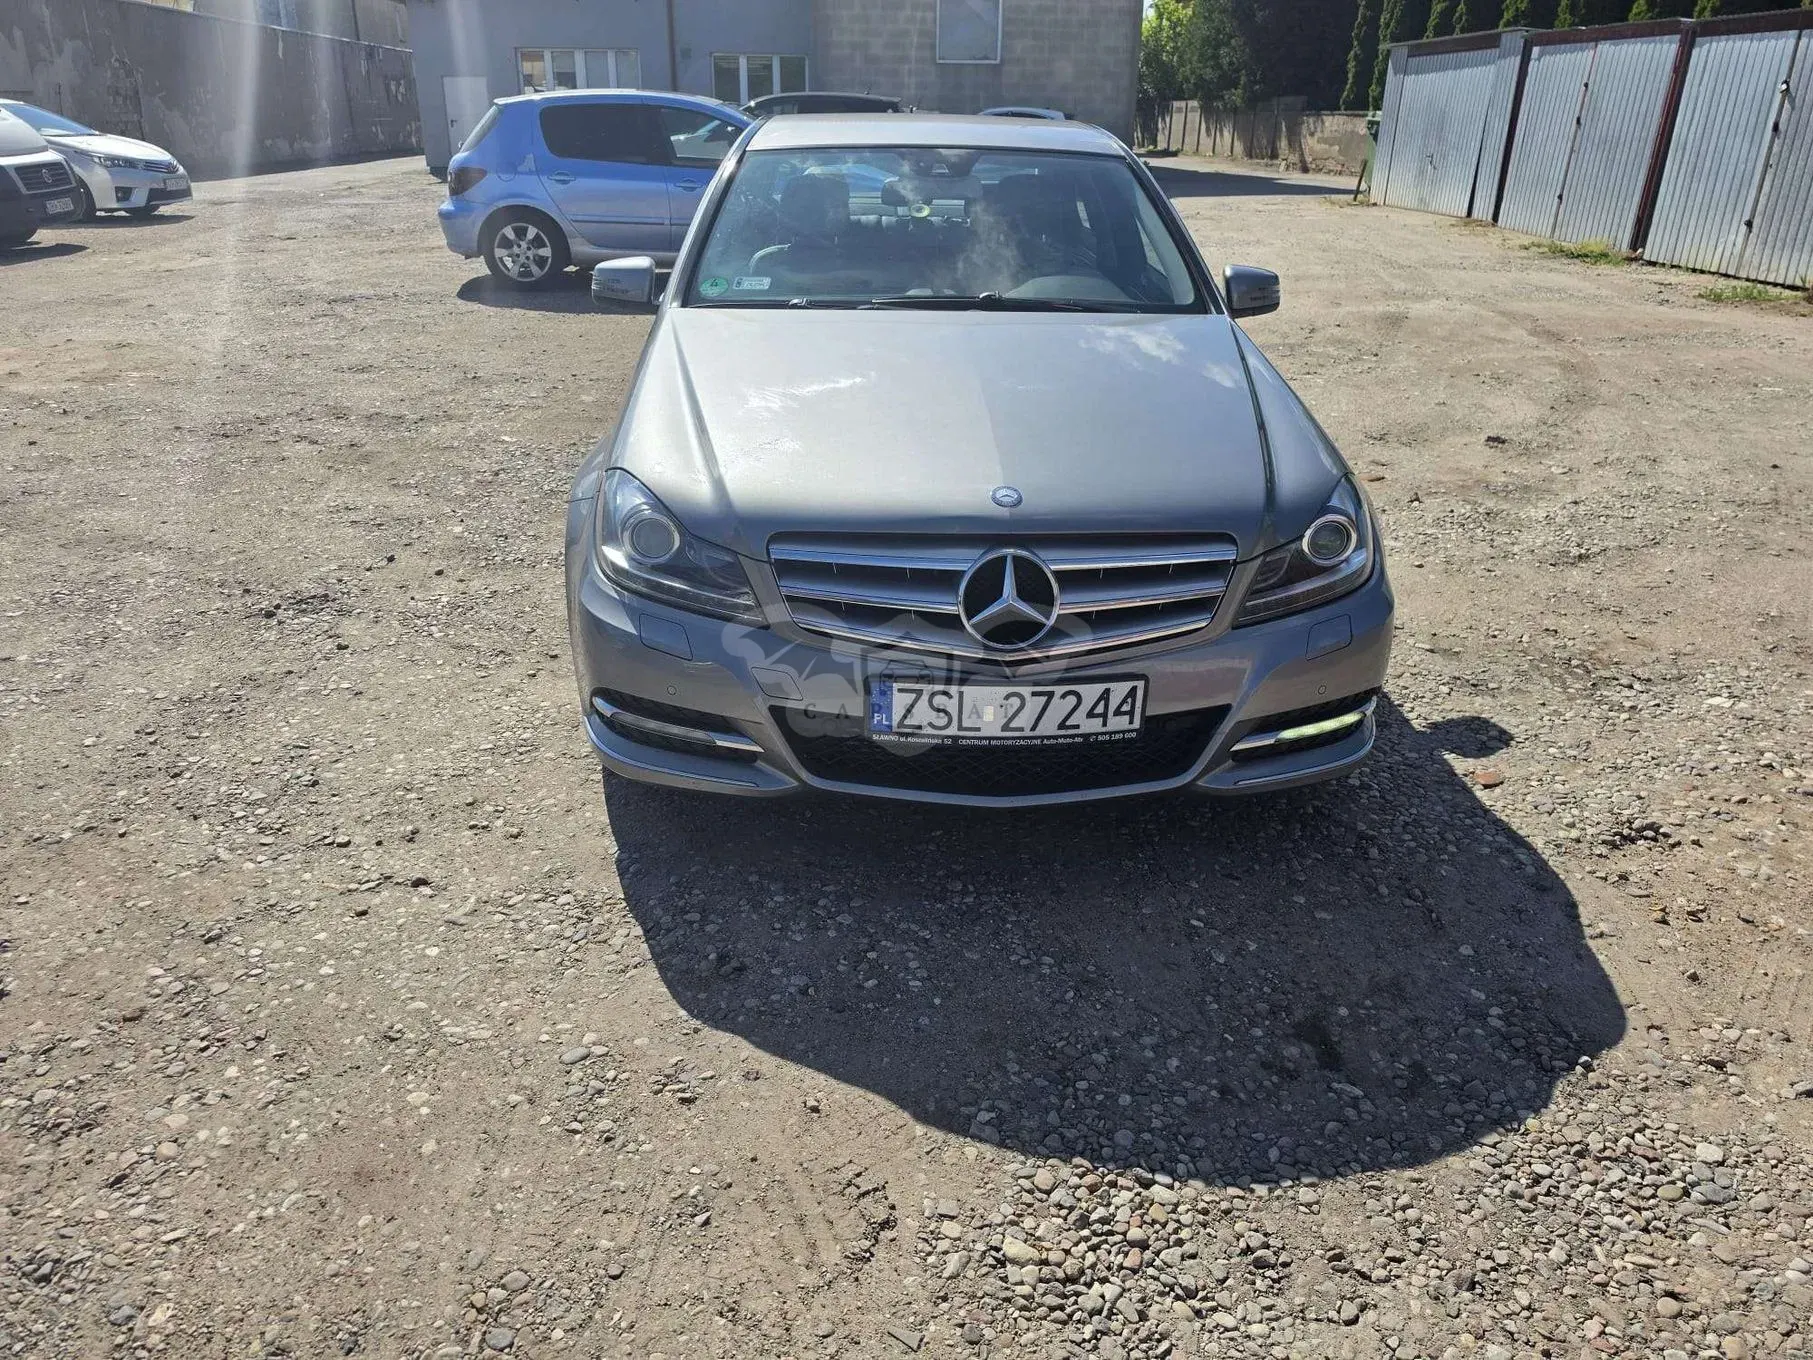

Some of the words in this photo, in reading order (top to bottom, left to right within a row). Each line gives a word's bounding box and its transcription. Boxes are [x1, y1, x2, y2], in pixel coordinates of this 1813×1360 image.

[896, 687, 981, 733] ZSL
[1000, 684, 1138, 733] 27244
[873, 712, 890, 725] PL
[990, 739, 1041, 747] MOTORYZACYJNE
